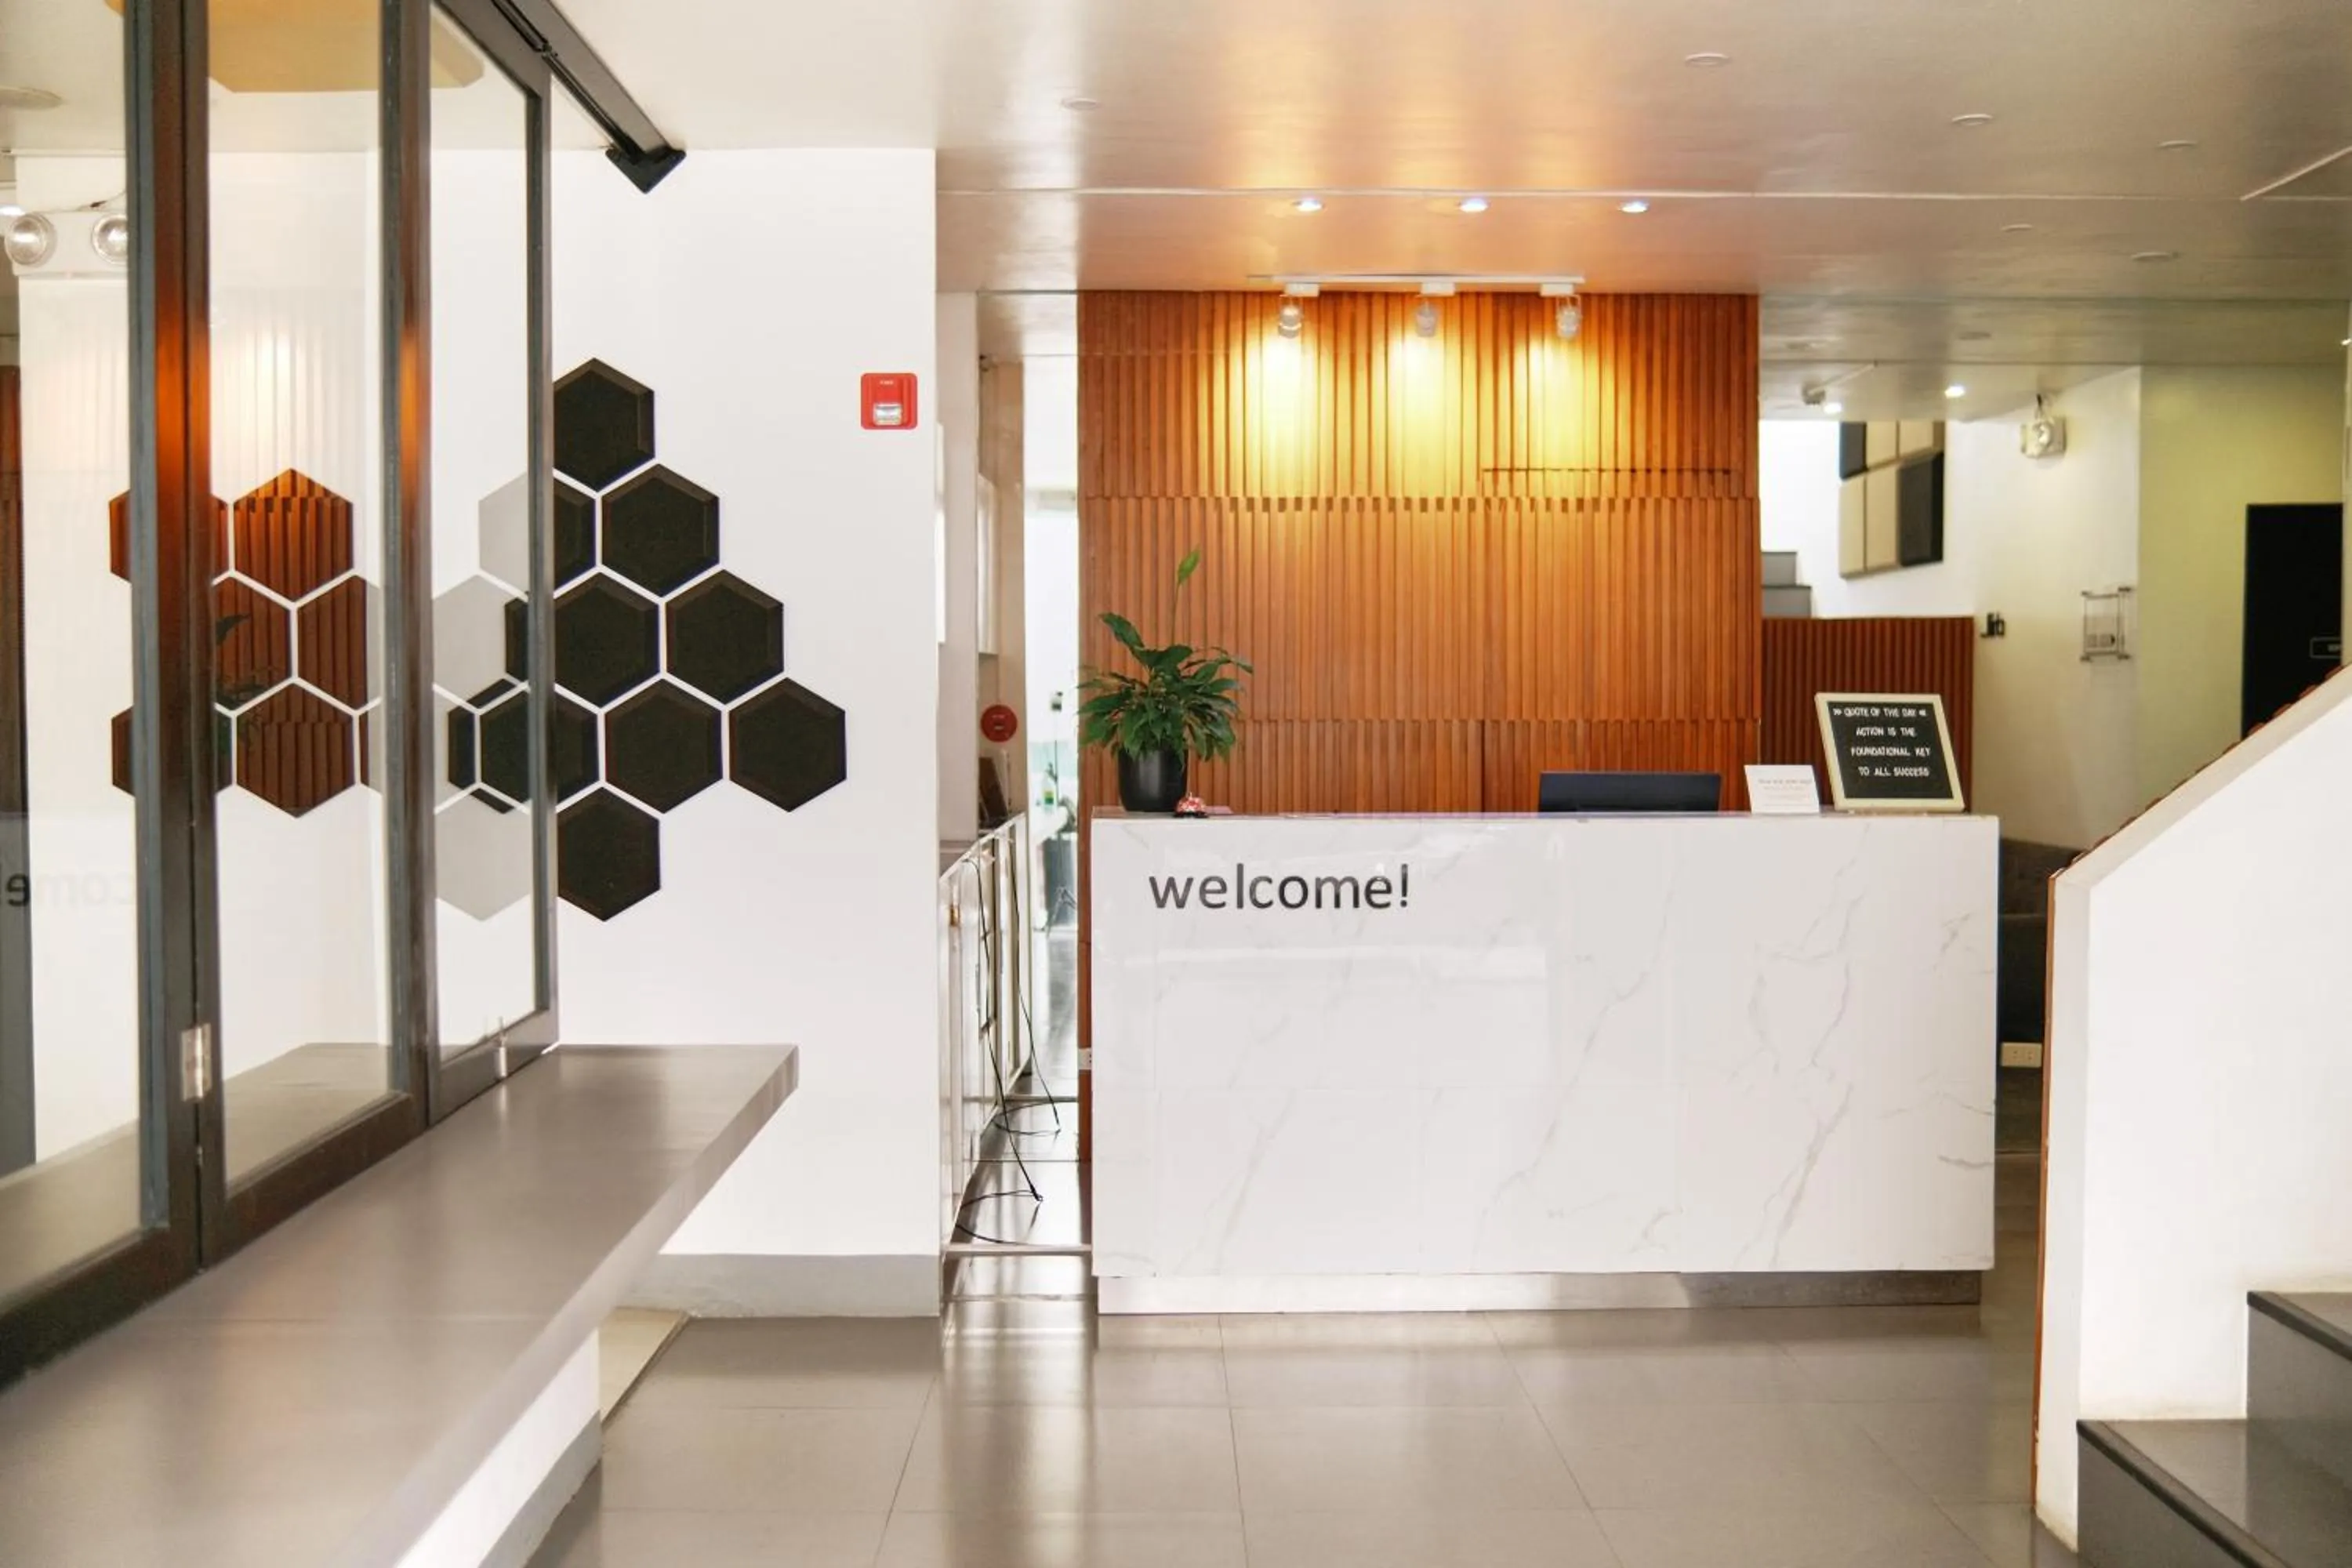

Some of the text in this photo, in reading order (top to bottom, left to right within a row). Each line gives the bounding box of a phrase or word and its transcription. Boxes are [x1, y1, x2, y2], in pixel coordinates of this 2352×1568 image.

[1844, 707, 1916, 717] QUOTE OF THE DAY
[1856, 727, 1916, 737] ACTION IS THE
[1851, 746, 1931, 757] FOUNDATIONAL KEY
[1858, 767, 1929, 776] TO ALL SUCCESS
[1148, 862, 1410, 909] welcome!
